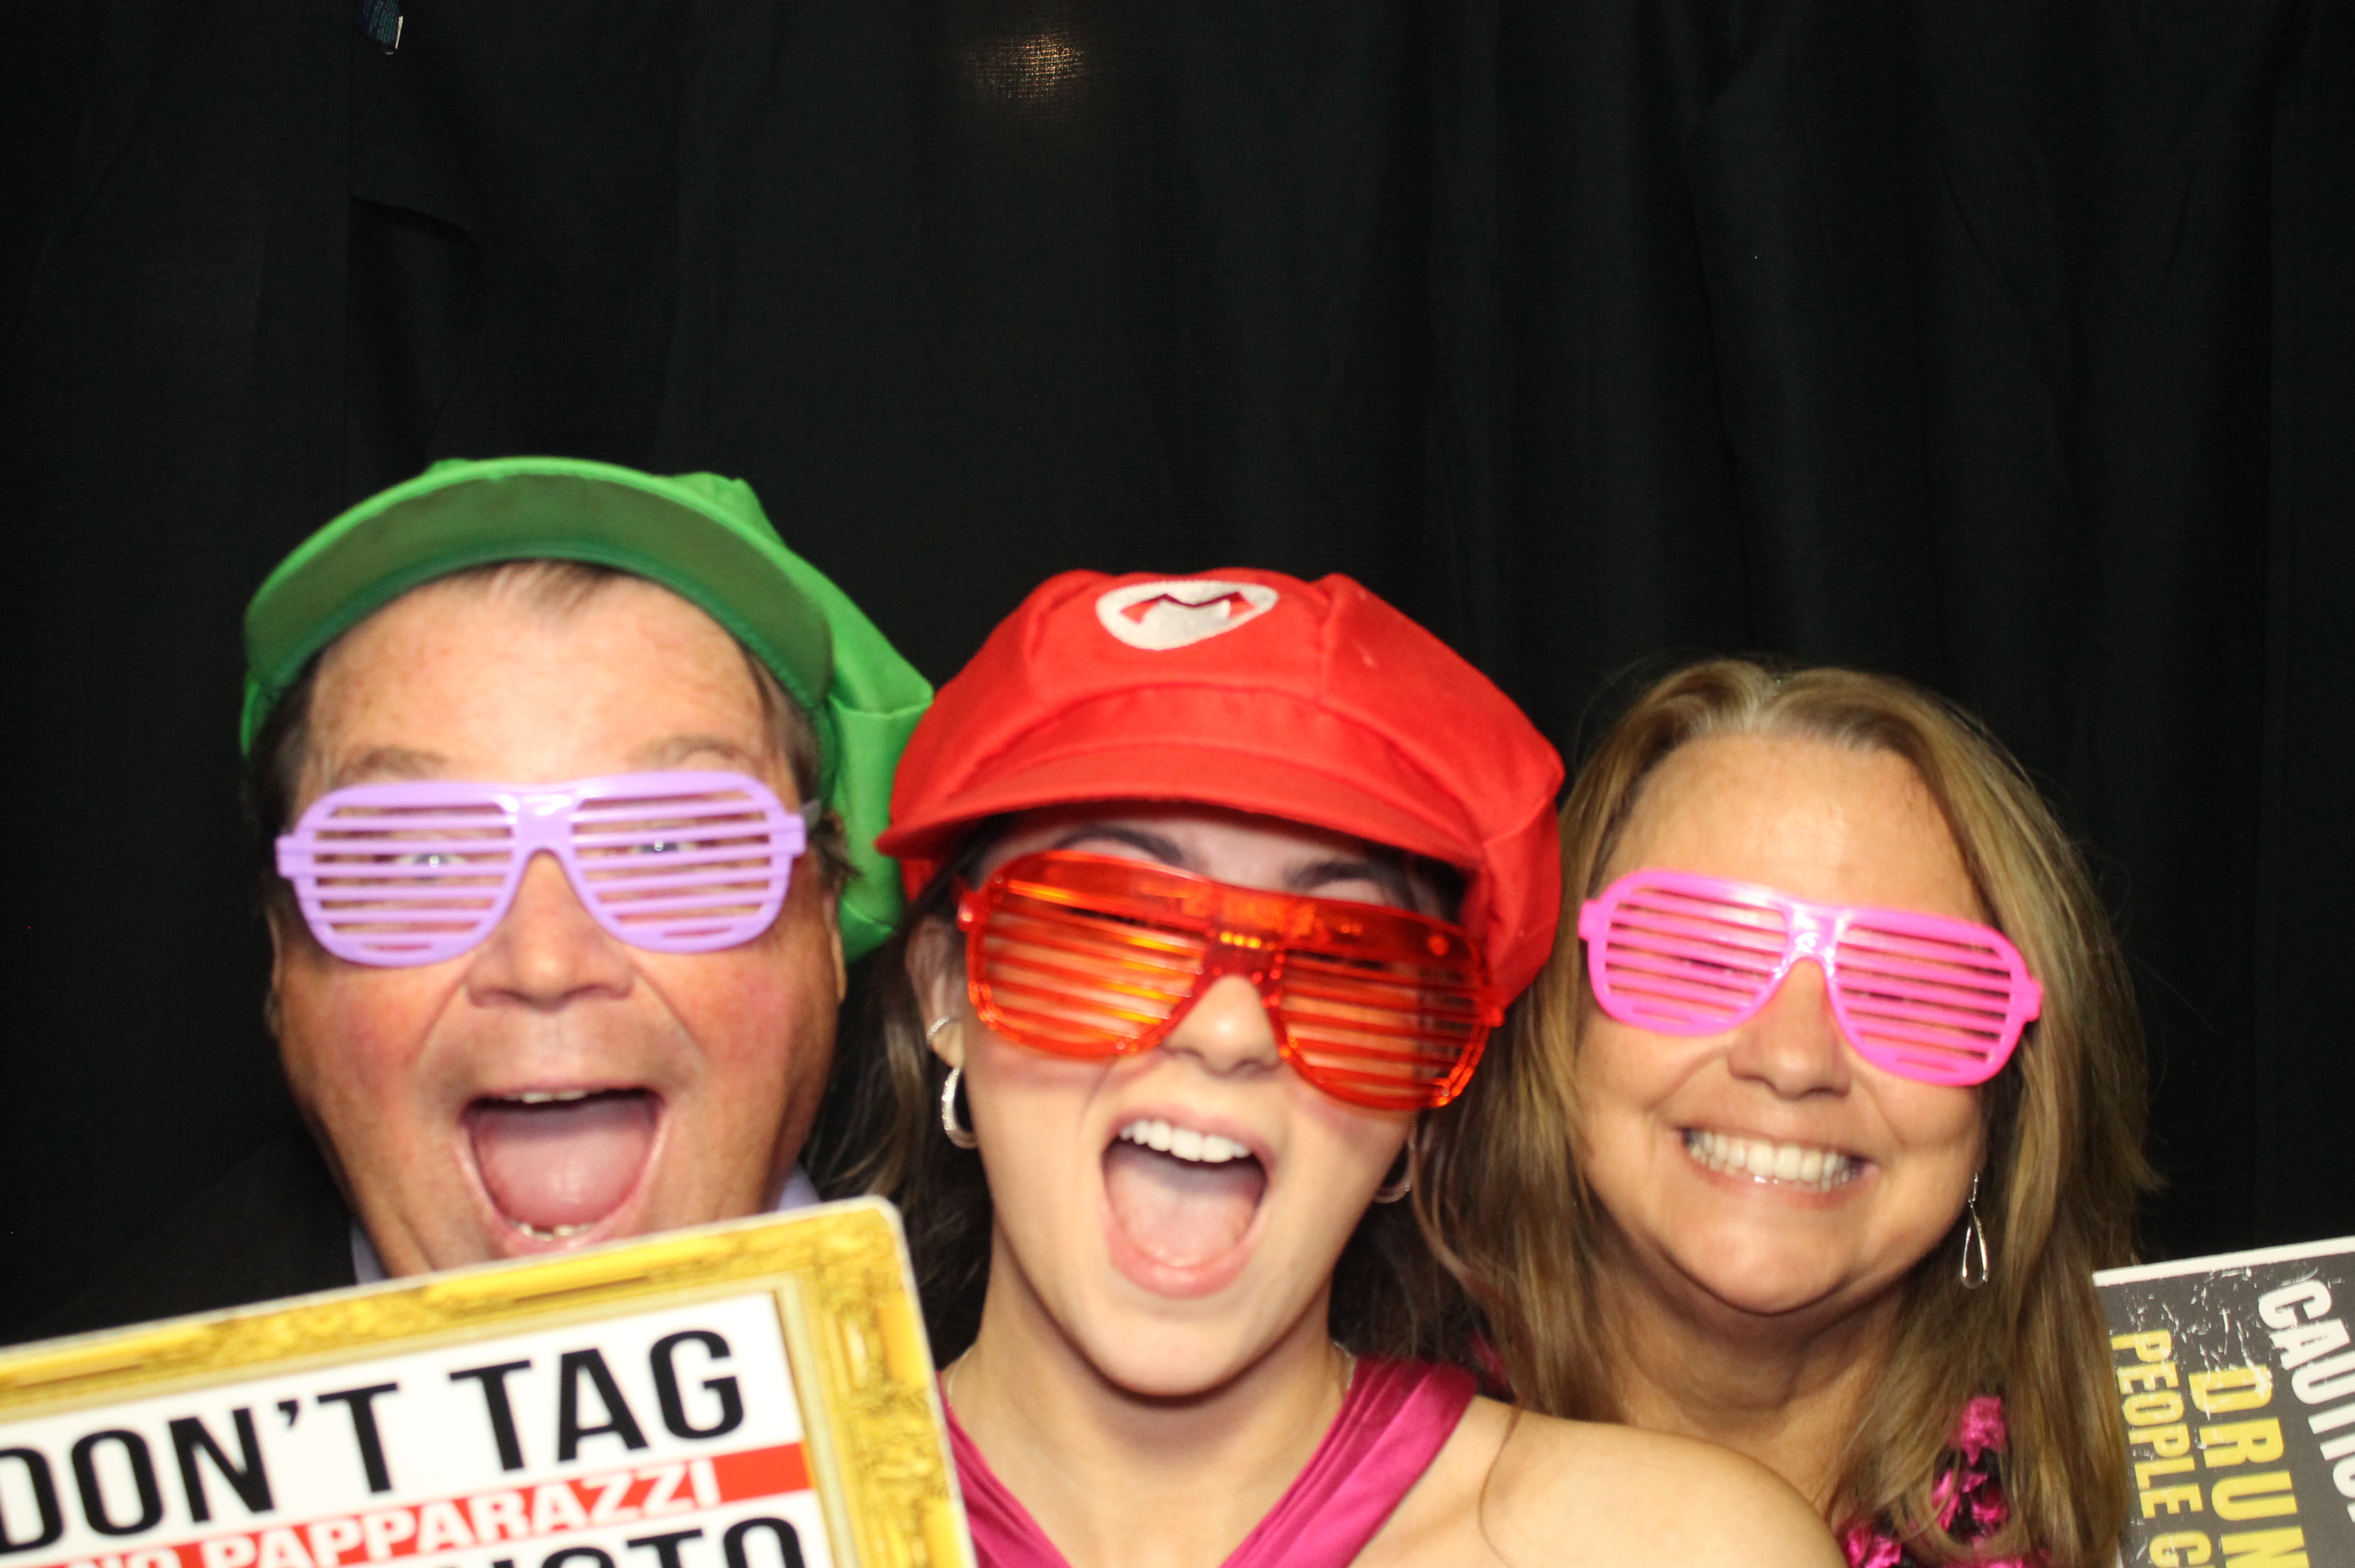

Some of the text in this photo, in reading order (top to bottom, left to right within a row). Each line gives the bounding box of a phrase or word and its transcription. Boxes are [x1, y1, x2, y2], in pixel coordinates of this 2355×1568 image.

[0, 1329, 744, 1554] DON'T TAG
[201, 1457, 721, 1568] PAPPARAZZI
[2110, 1329, 2203, 1519] PEOPLE
